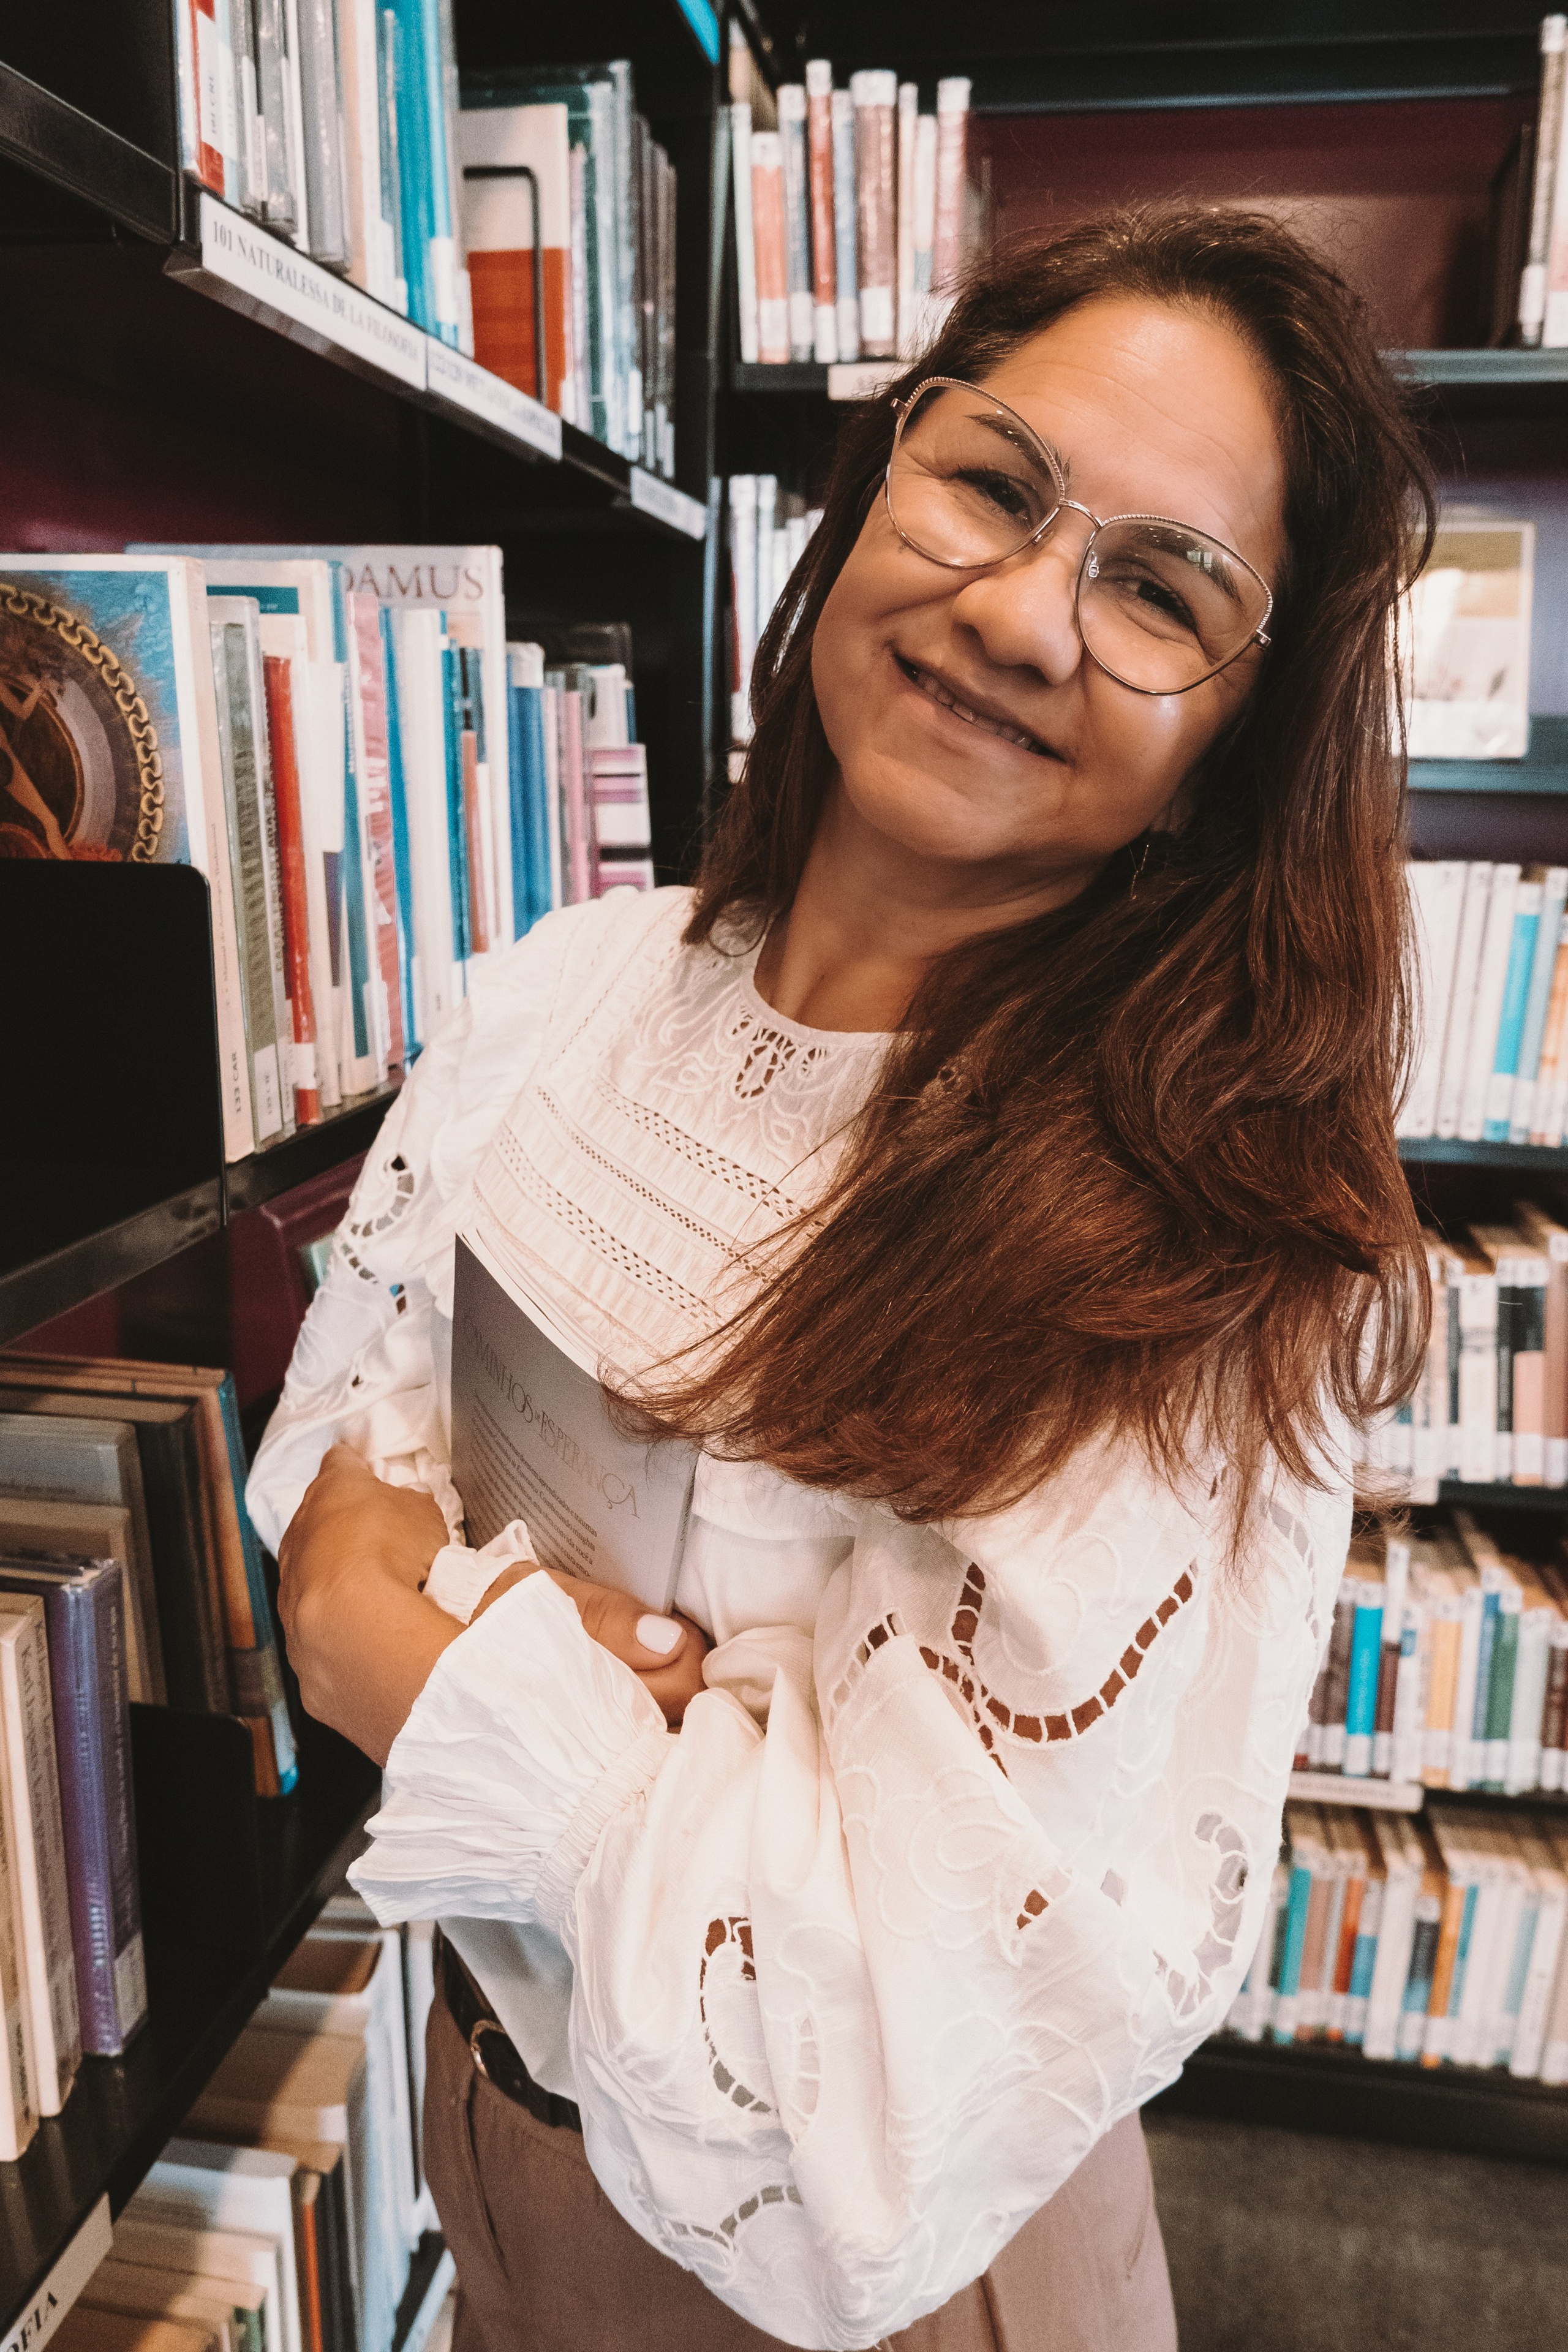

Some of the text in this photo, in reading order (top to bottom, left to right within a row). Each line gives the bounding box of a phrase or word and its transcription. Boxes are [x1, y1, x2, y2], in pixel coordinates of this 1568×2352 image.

[213, 221, 233, 252] 101
[575, 1512, 597, 1537] traumas
[572, 1527, 595, 1551] insights
[576, 1545, 589, 1561] você
